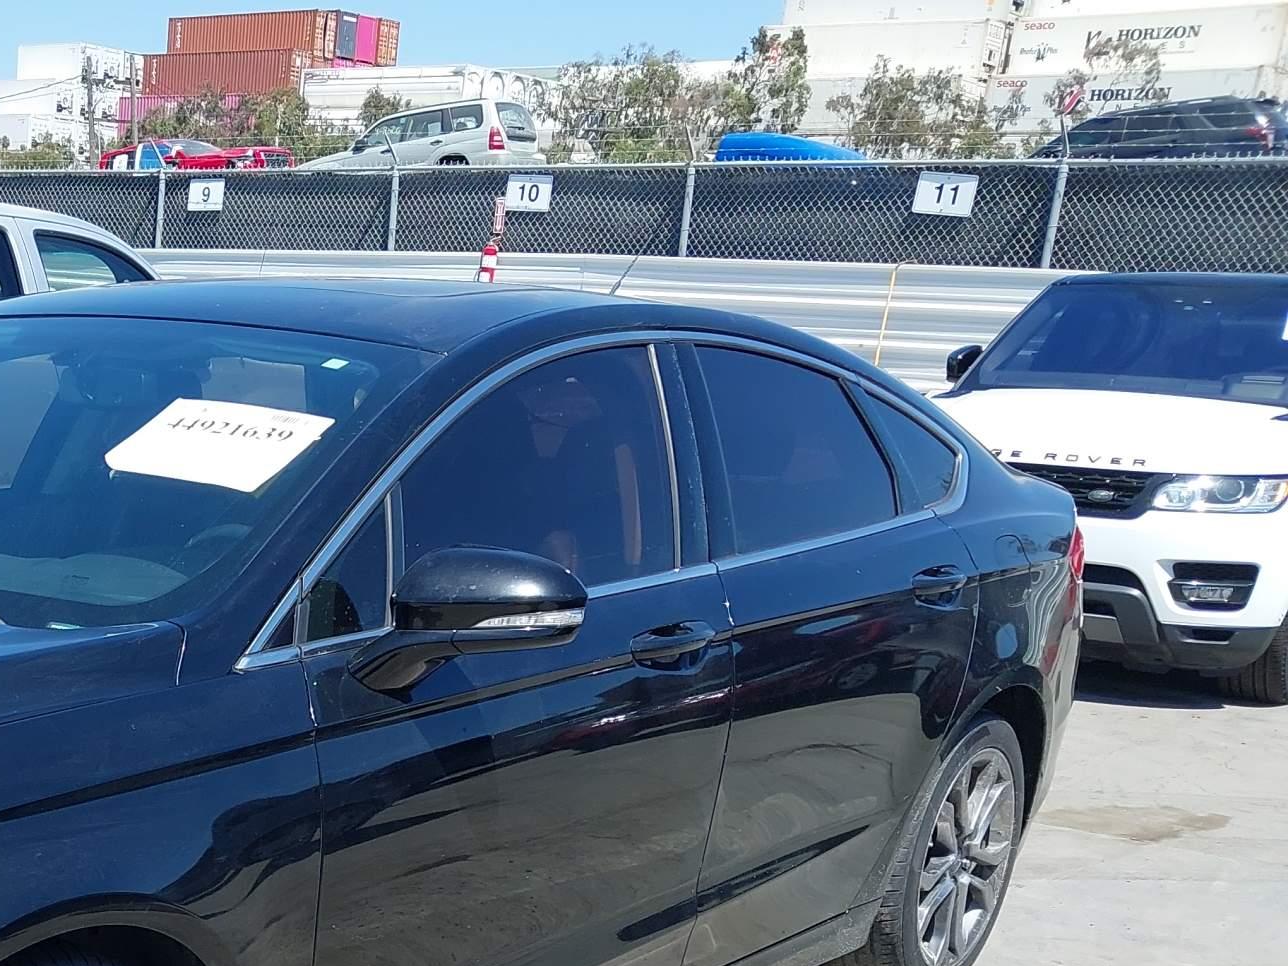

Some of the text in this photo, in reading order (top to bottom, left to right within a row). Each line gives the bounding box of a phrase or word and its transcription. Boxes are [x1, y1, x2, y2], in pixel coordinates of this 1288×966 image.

[1024, 21, 1056, 31] seaco
[1116, 24, 1203, 42] HORIZON
[996, 79, 1028, 88] seaco
[1089, 87, 1173, 102] HORIZON
[201, 186, 211, 203] 9
[518, 183, 540, 203] 10
[934, 182, 960, 206] 11
[167, 416, 294, 442] 44921639
[1043, 451, 1147, 467] ROVER
